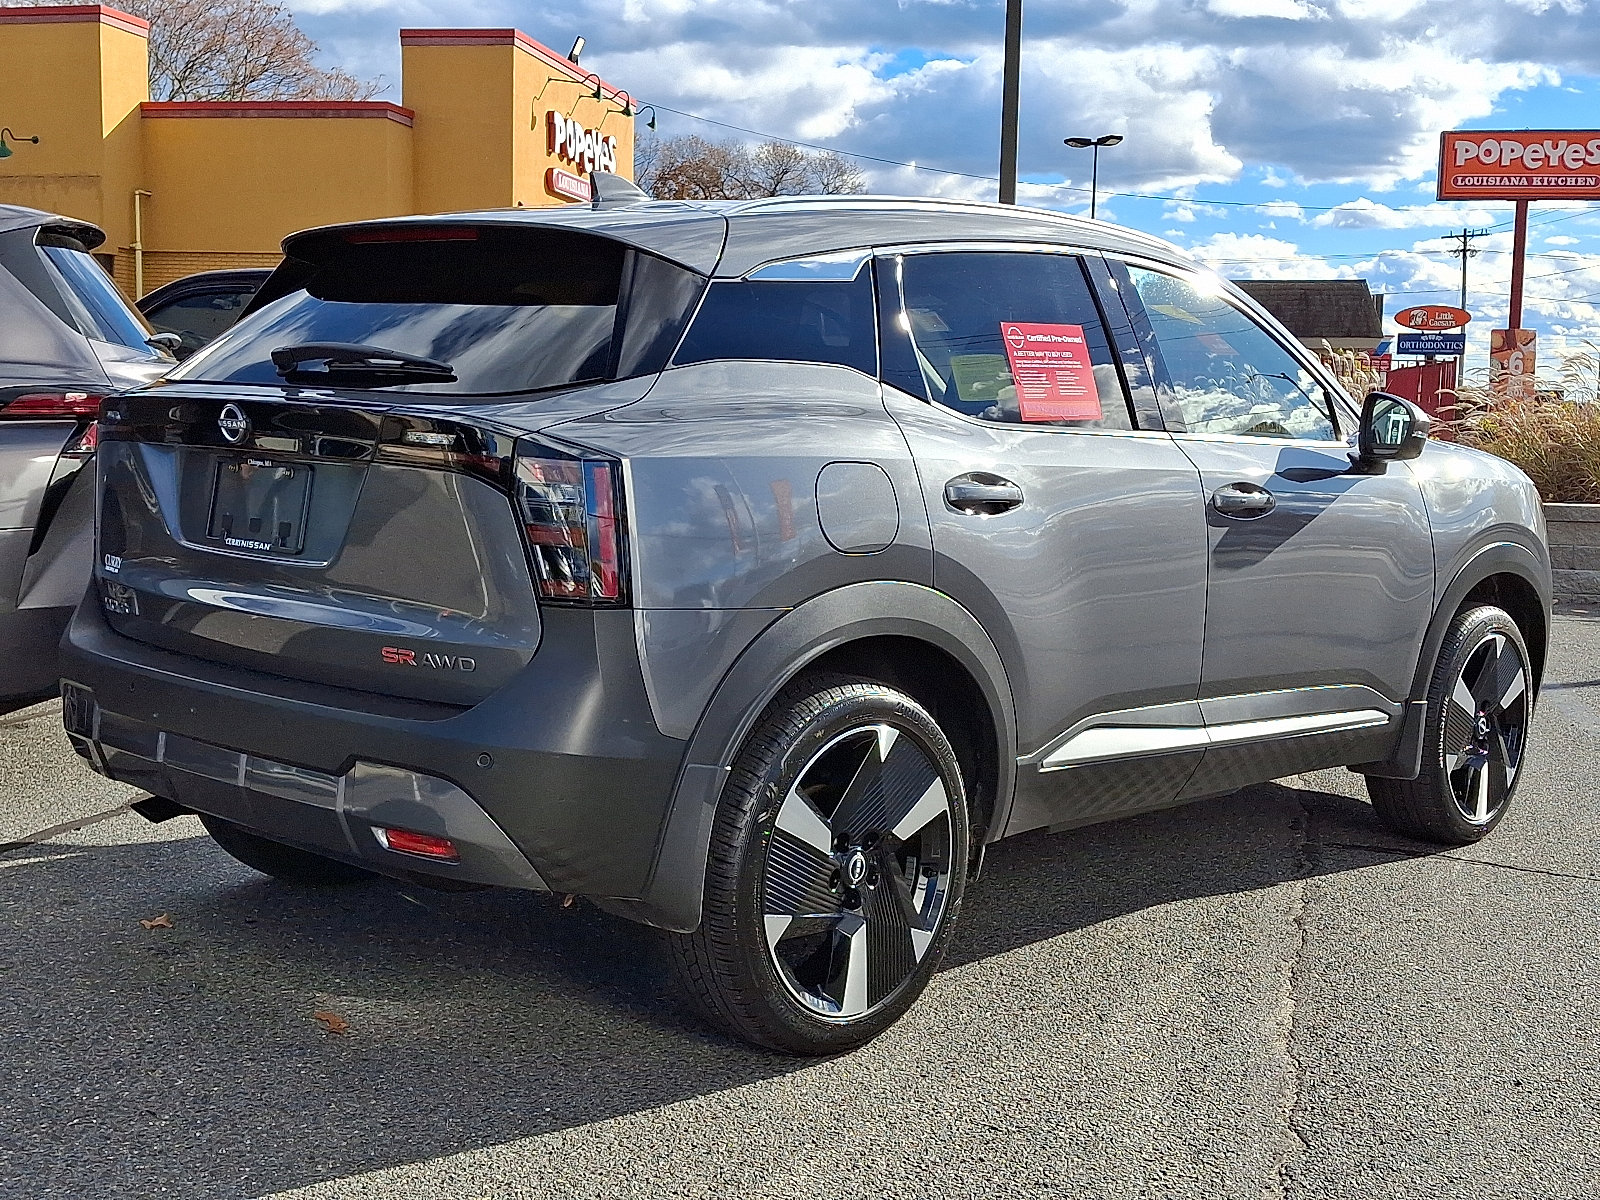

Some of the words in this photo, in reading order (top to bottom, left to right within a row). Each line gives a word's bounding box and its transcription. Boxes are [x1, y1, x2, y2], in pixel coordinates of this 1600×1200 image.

[1456, 176, 1528, 187] LOUISIANA
[1532, 176, 1597, 187] KITCHEN
[1435, 311, 1454, 320] Little
[1428, 318, 1457, 327] Caesars
[1399, 341, 1464, 350] ORTHODONTICS
[381, 646, 418, 667] SR
[421, 652, 476, 672] AWD
